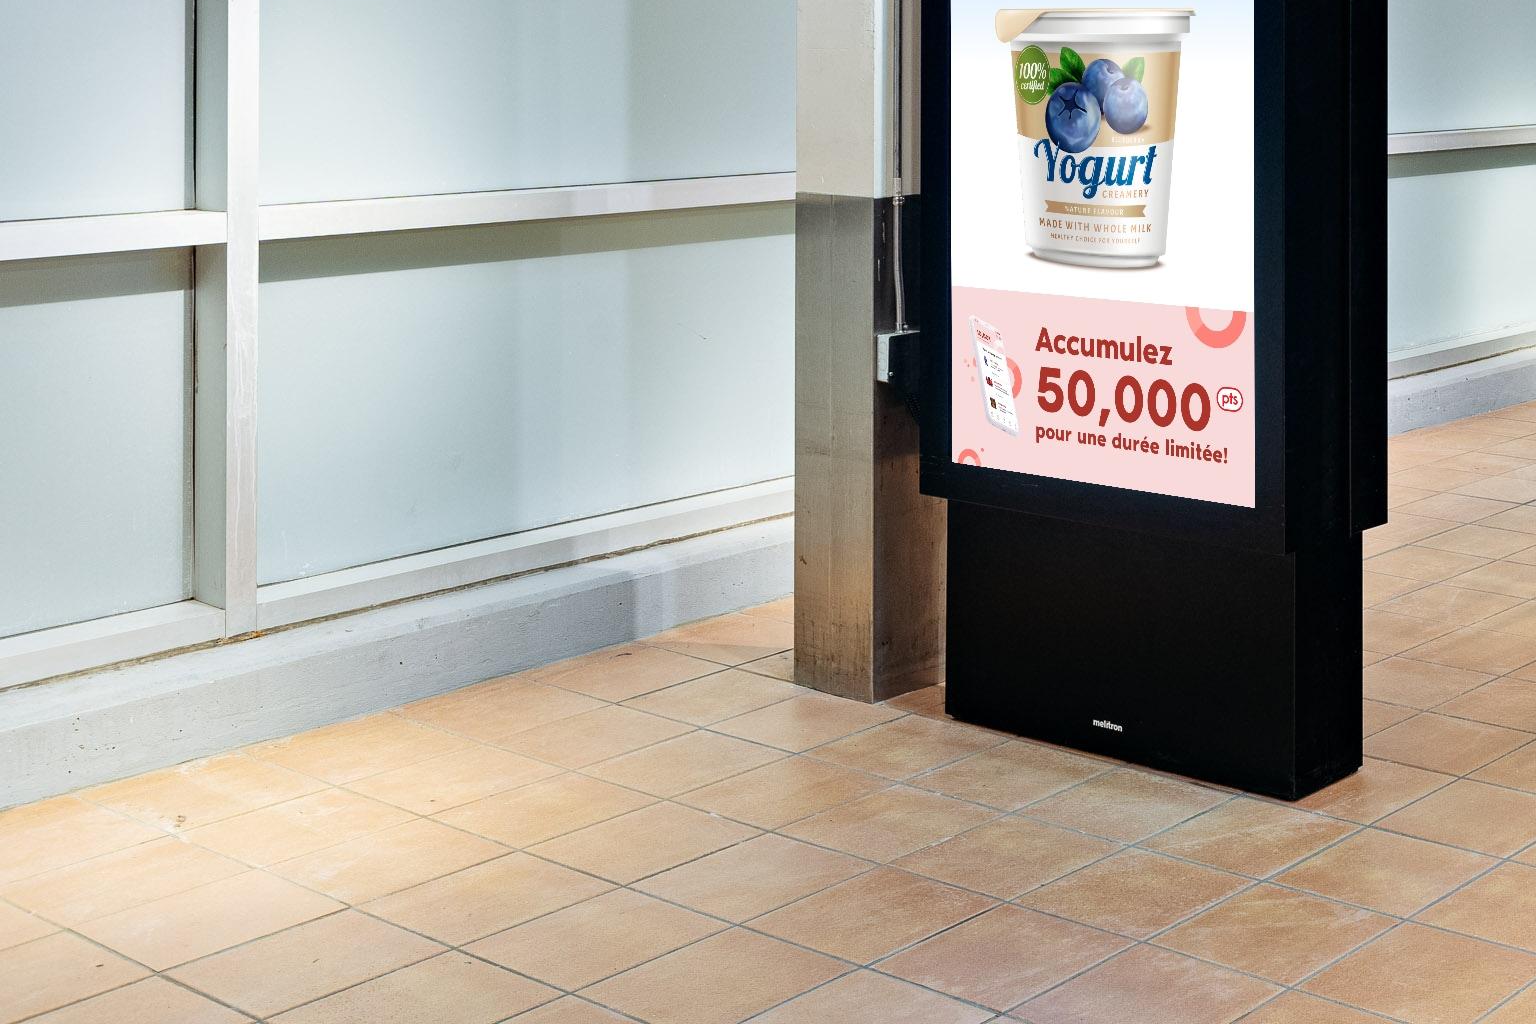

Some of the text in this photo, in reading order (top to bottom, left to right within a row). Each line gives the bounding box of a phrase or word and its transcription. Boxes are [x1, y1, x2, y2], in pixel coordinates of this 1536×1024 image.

[1019, 62, 1047, 80] 100%
[1020, 80, 1045, 93] certified
[1034, 139, 1157, 199] Yogurt
[1102, 189, 1149, 199] CREAMERY
[1039, 217, 1152, 233] MADE WITH WHOLE MILK
[1035, 327, 1173, 365] Accumulez
[1037, 367, 1239, 432] 50,000 pts
[1035, 425, 1228, 464] pour une durée limitée!
